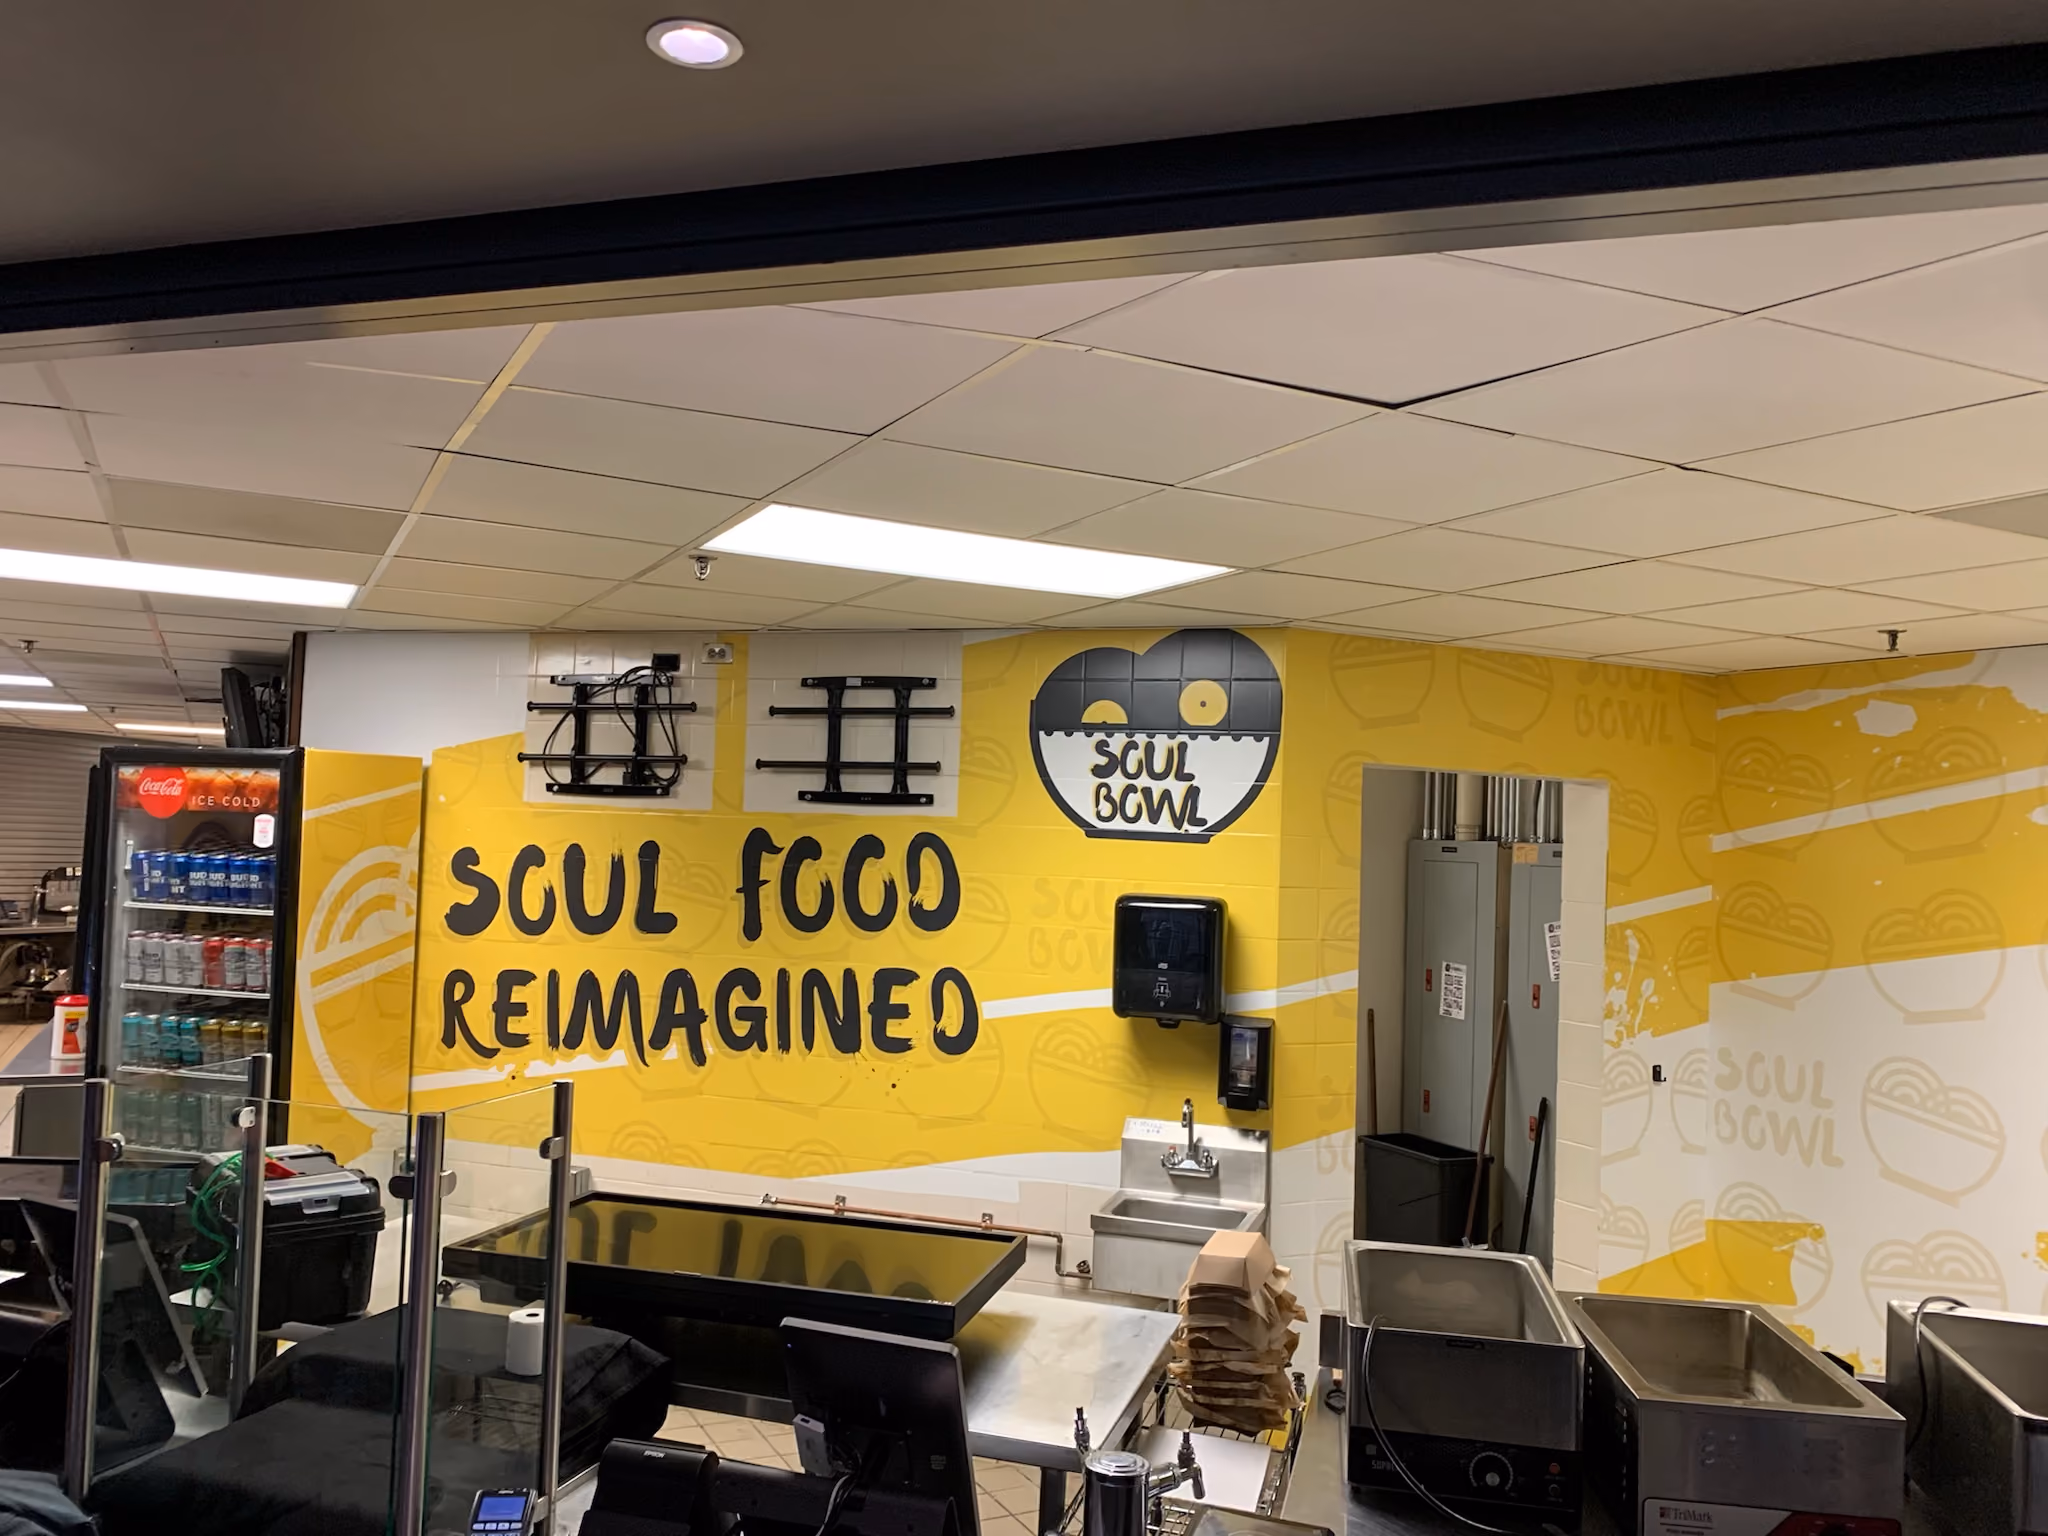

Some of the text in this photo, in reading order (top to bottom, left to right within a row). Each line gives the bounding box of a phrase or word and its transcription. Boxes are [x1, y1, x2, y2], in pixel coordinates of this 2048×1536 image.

[1574, 693, 1673, 746] BOWL
[1091, 739, 1195, 782] SOUL
[192, 796, 261, 808] ICE COLD
[1095, 782, 1208, 830] BOWL
[444, 826, 961, 942] SOUL FOOD
[440, 966, 979, 1068] REIMAGINED
[1714, 1047, 1834, 1110] SOUL
[1714, 1098, 1844, 1168] BOWL
